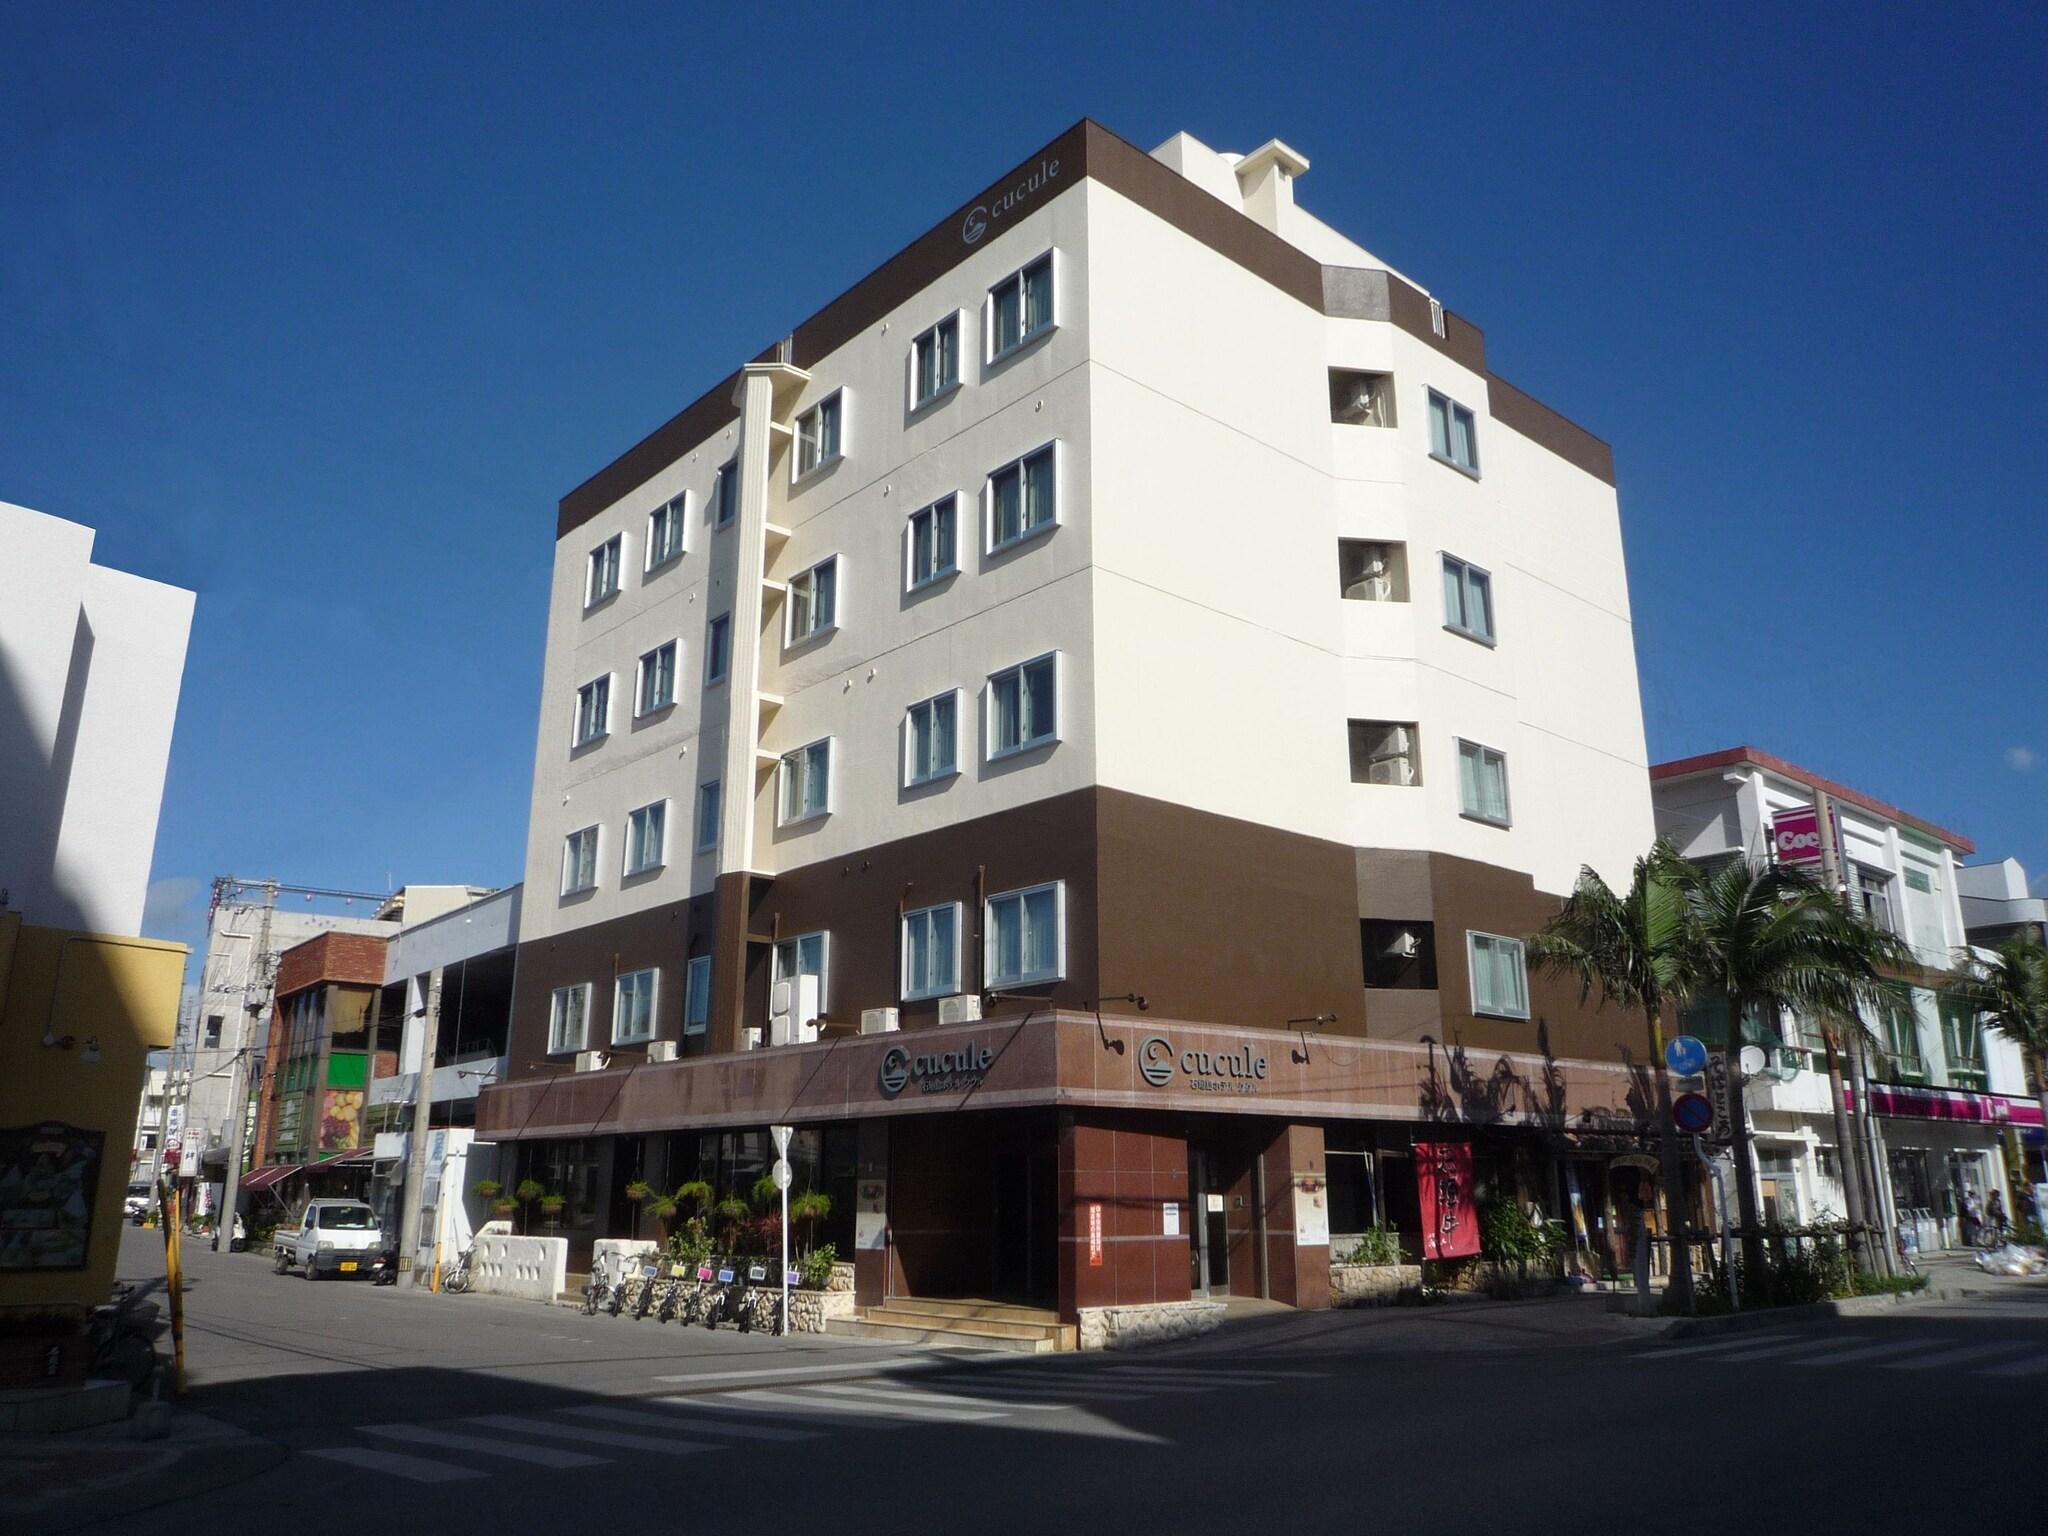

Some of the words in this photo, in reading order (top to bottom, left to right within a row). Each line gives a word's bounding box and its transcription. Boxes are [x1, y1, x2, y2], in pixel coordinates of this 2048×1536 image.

[992, 159, 1060, 218] cucule
[1778, 830, 1821, 852] Coc
[913, 1040, 993, 1077] cucule
[1180, 1043, 1266, 1079] cucule
